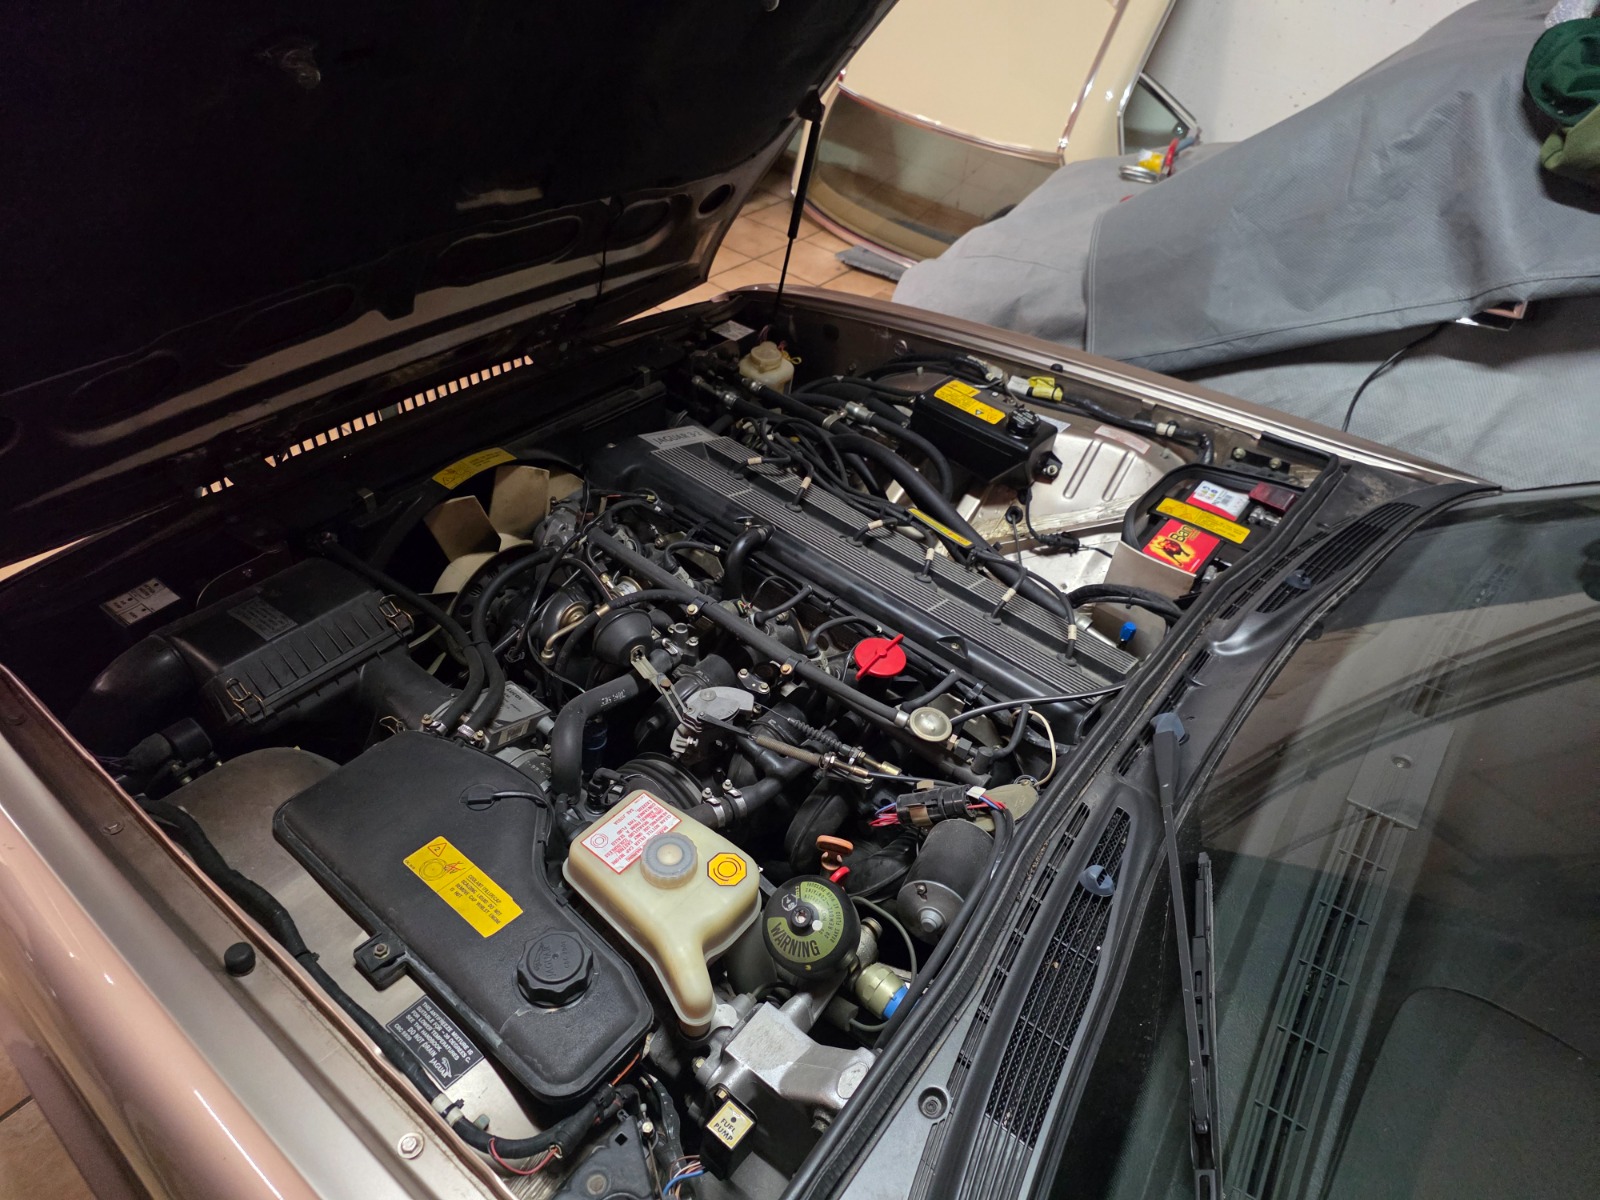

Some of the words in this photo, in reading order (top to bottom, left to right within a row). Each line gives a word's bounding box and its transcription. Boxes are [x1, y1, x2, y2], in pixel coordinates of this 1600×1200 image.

[1169, 524, 1192, 544] Ban
[630, 821, 640, 829] FROM
[660, 814, 670, 823] CLEAN
[616, 826, 626, 834] FLUID
[646, 824, 659, 835] BOTTLE
[611, 834, 624, 845] SEALED
[634, 835, 645, 845] FILLER
[611, 853, 624, 864] BEFORE
[461, 879, 476, 893] SCALDING
[468, 874, 484, 888] COOLANT
[806, 882, 826, 892] PRESSURE
[806, 888, 827, 901] CONTAINS
[826, 891, 835, 901] HIGH
[455, 883, 469, 895] REMOVE
[476, 902, 489, 913] WHILST
[488, 913, 500, 923] ENGINE
[825, 906, 834, 929] REMOVE
[771, 922, 820, 957] WARNING
[829, 927, 839, 943] BRAKE
[542, 944, 557, 977] JAGUAR
[405, 1014, 414, 1023] SEE
[413, 1022, 422, 1030] THE
[422, 1002, 431, 1010] THIS
[429, 1009, 452, 1032] ANTIFREEZE
[450, 1031, 469, 1050] MIXTURE
[411, 1010, 420, 1018] FOR
[418, 1017, 432, 1031] LOWER
[430, 1030, 459, 1060] TEMPERATURES
[416, 1006, 434, 1023] SUITABLE
[432, 1022, 441, 1030] FOR
[448, 1038, 467, 1057] DEGREES
[407, 1027, 416, 1035] DO
[413, 1033, 424, 1043] NOT
[422, 1042, 436, 1056] DRAIN
[429, 1057, 449, 1078] JAGUAR
[713, 1122, 734, 1141] PUMP
[720, 1118, 736, 1133] FUEL
